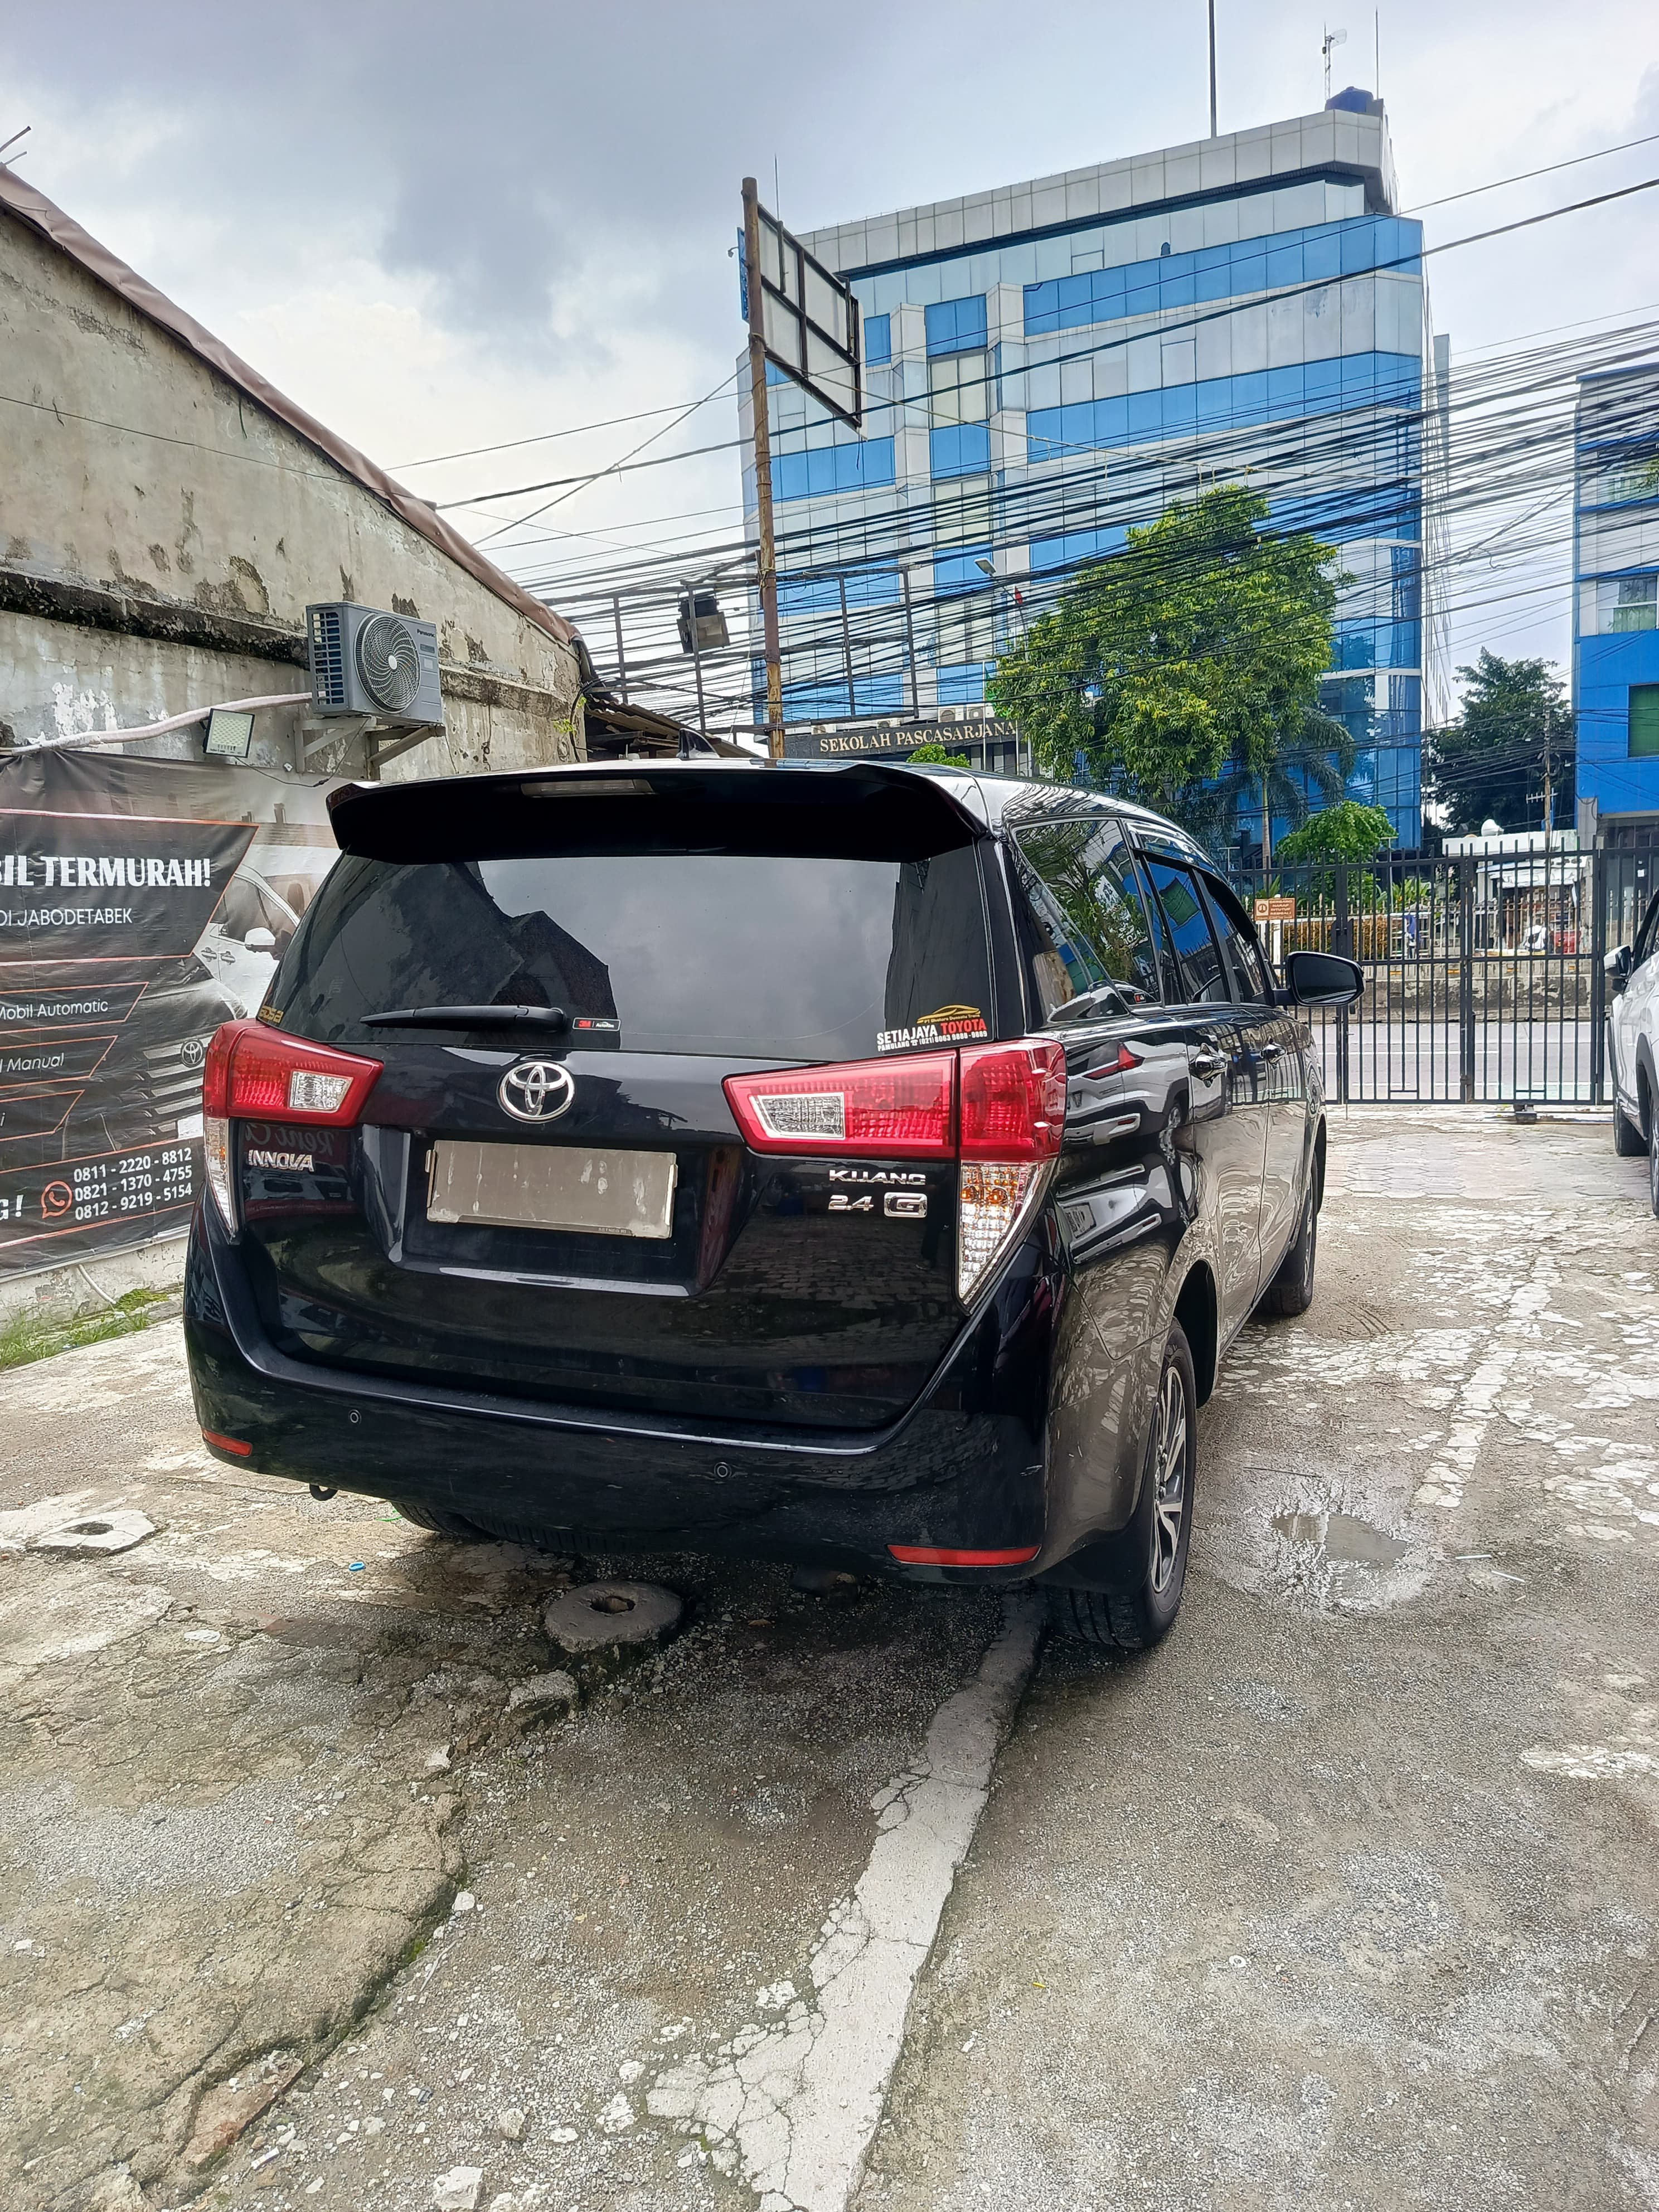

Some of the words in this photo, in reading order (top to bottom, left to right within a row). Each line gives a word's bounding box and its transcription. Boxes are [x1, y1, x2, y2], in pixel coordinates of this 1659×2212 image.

[820, 733, 891, 752] SEKOLAH
[895, 722, 1016, 745] PASCASARJANA
[0, 855, 34, 886] IL
[40, 856, 211, 887] TERMURAH!
[17, 908, 132, 926] JABODETABEK
[37, 998, 108, 1017] Automatic
[940, 1018, 987, 1035] TOYOTA
[877, 1041, 910, 1051] PAMULANG
[7, 1052, 64, 1072] Manual
[74, 1164, 106, 1182] 0811
[119, 1156, 151, 1174] 2220
[162, 1147, 192, 1165] 8812
[249, 1149, 314, 1172] INNOVA
[75, 1182, 107, 1201] 0821
[120, 1173, 152, 1191] 1370
[163, 1165, 192, 1182] 4755
[75, 1201, 109, 1220] 0812
[120, 1192, 153, 1210] 9219
[164, 1182, 192, 1201] 5154
[828, 1195, 874, 1211] 2.4
